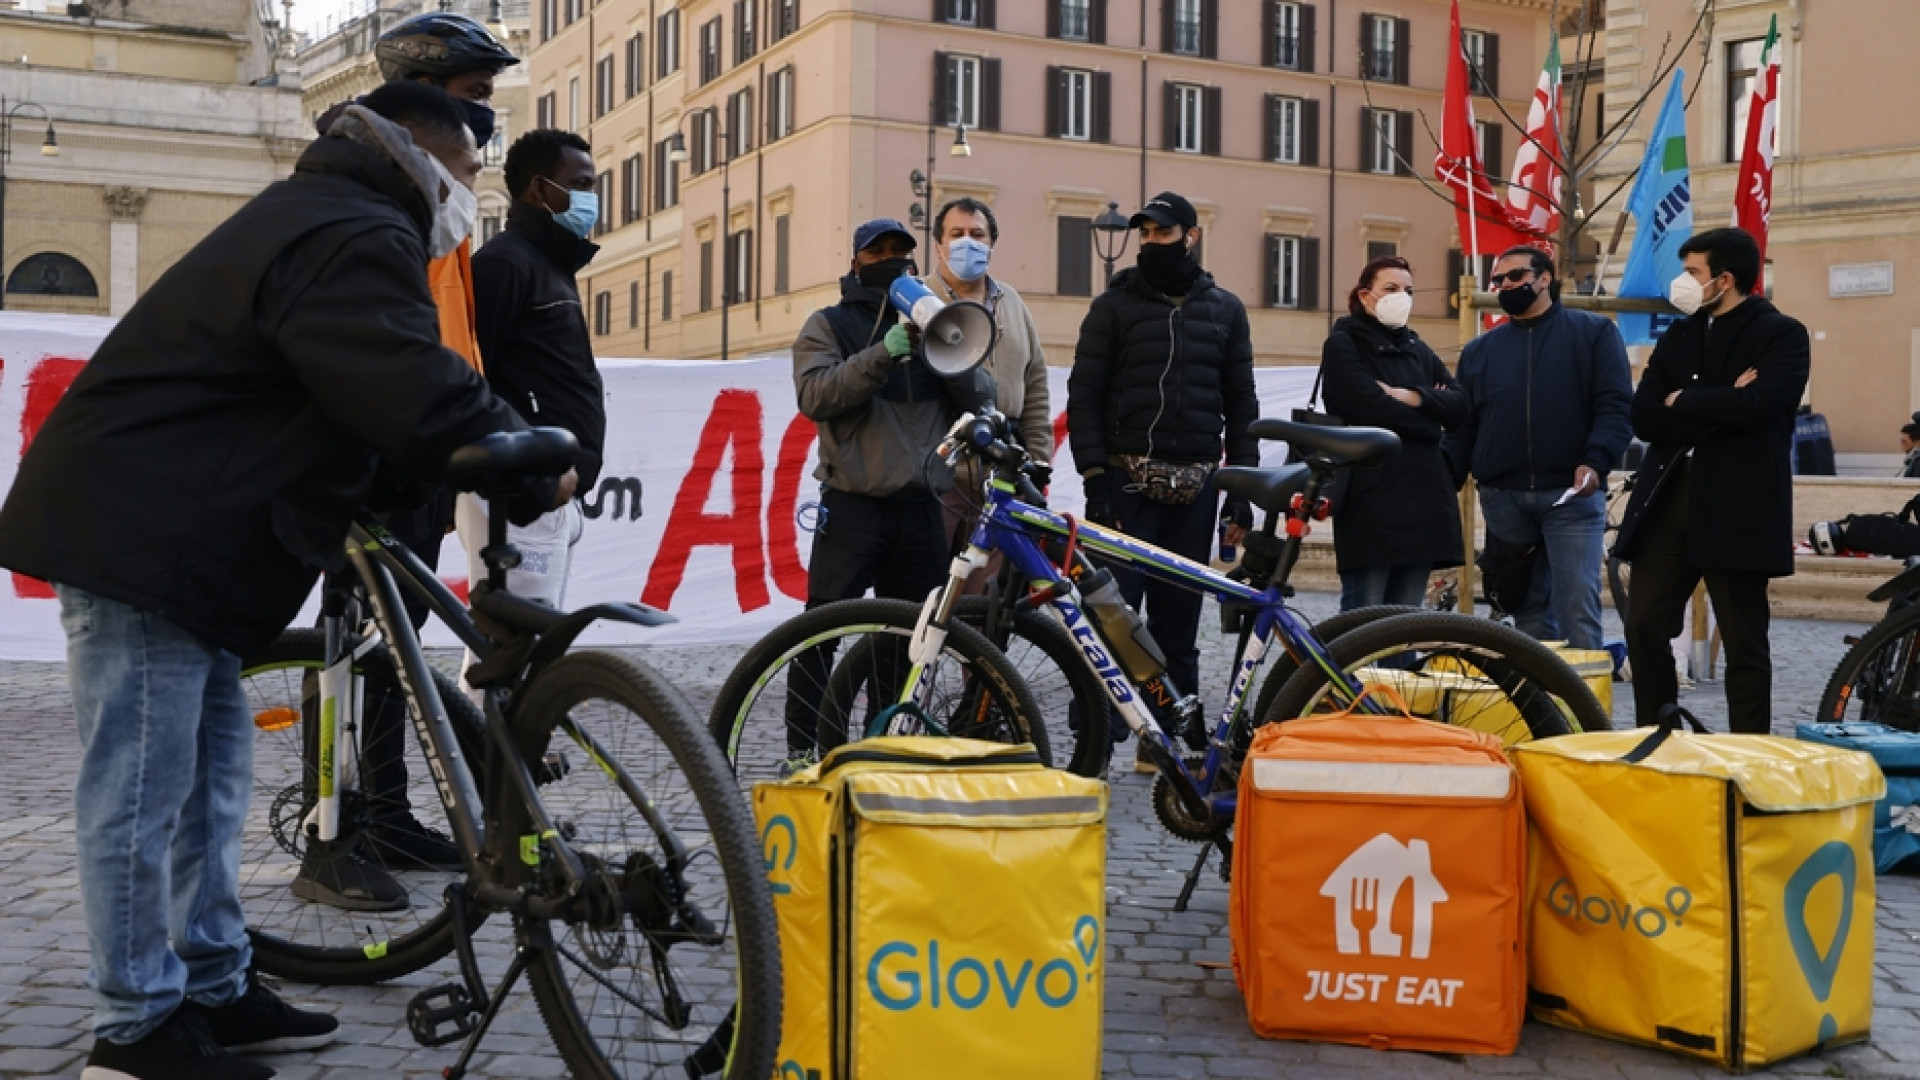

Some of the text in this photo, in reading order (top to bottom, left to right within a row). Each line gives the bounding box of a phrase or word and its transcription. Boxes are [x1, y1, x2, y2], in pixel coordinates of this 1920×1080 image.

[867, 939, 1078, 1011] Glovo
[1302, 970, 1465, 1008] JUST EAT
